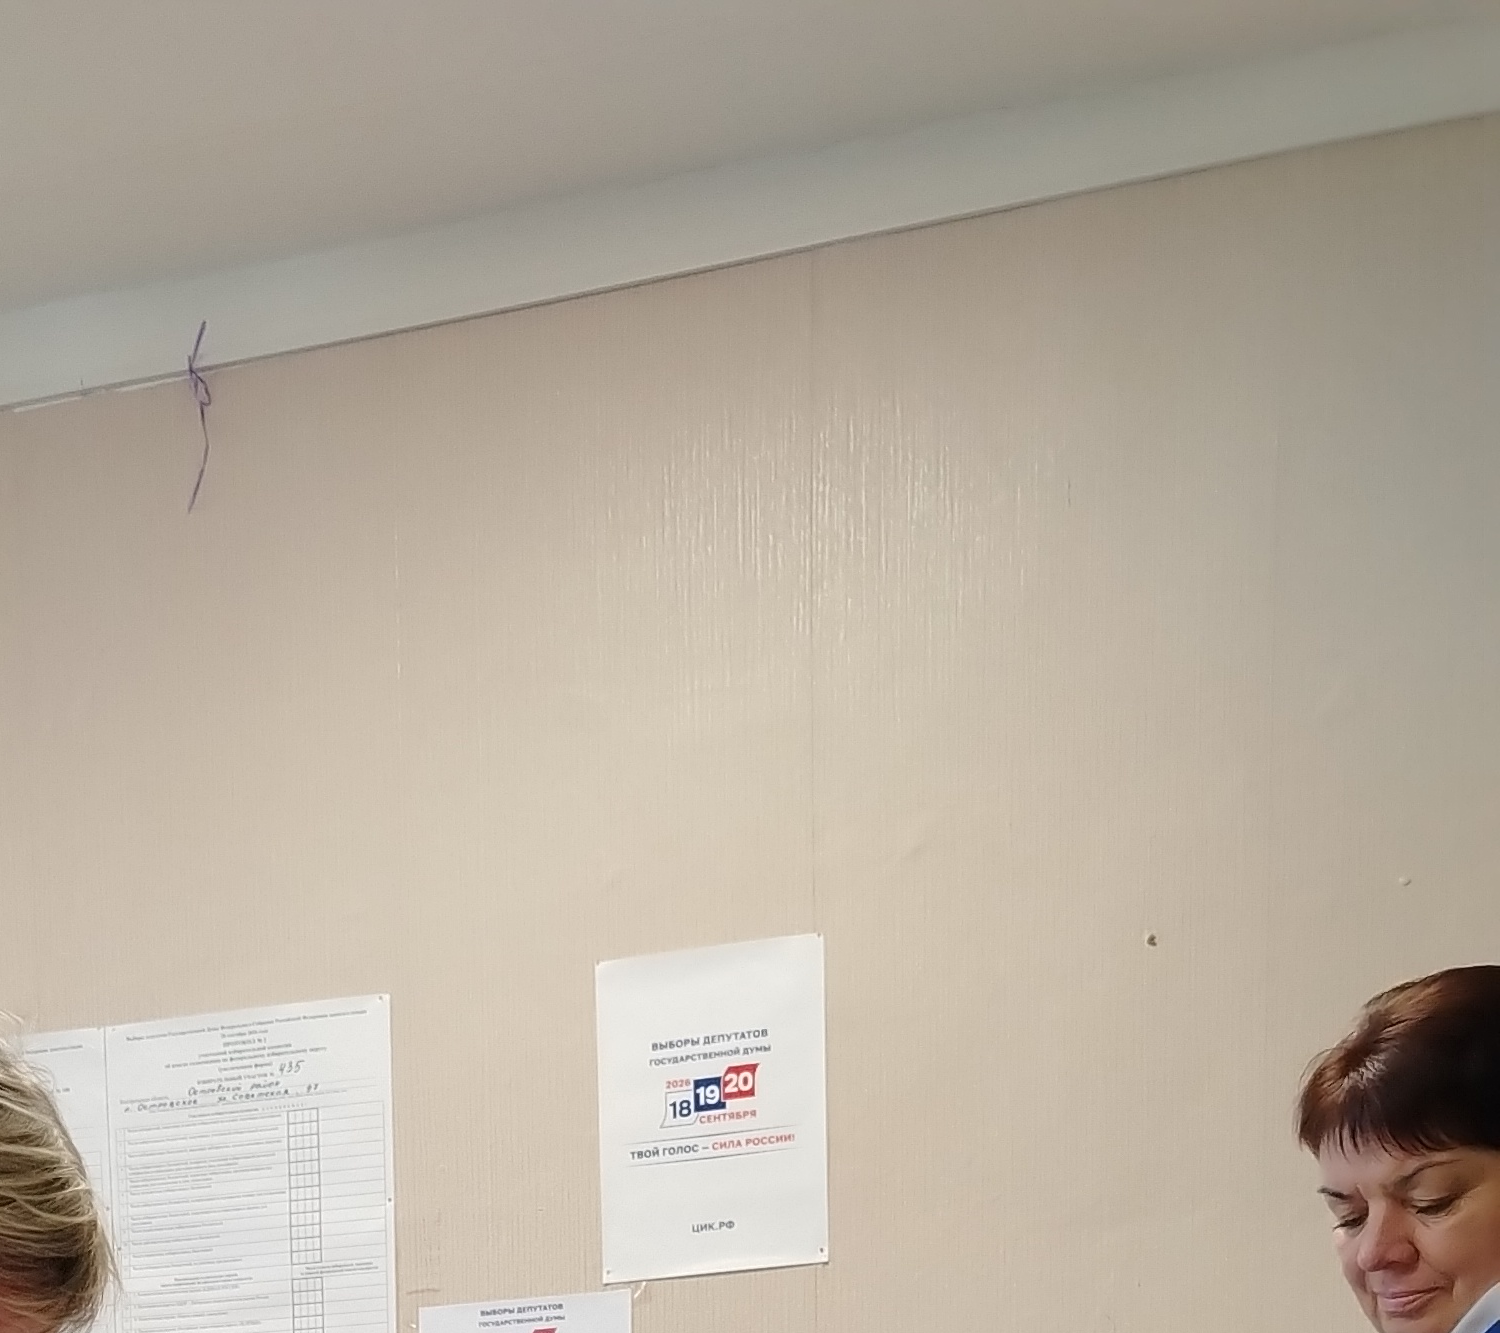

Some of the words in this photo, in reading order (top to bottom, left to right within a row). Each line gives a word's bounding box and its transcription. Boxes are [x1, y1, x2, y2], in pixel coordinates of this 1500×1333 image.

[651, 1037, 699, 1052] ВЫБОРЫ
[703, 1028, 768, 1046] ДЕПУТАТОВ
[649, 1046, 740, 1066] ГОСУДАРСТВЕННОЙ
[743, 1044, 771, 1056] ДУМЫ
[279, 1060, 305, 1075] 435
[725, 1071, 753, 1093] 20
[666, 1078, 691, 1089] 2026
[697, 1086, 719, 1106] 19
[669, 1100, 691, 1119] 18
[699, 1109, 756, 1124] СЕНТЯБРЯ
[630, 1145, 660, 1161] ТВОЙ
[663, 1144, 699, 1157] ГОЛОС
[712, 1138, 742, 1151] СИЛА
[745, 1134, 795, 1147] РОССИИ!
[692, 1220, 735, 1234] ЦИК.РФ
[480, 1307, 515, 1317] ВЫБОРЫ
[517, 1303, 563, 1314] ДЕПУТАТОВ
[479, 1316, 544, 1327] ГОСУДАРСТВЕННОЙ
